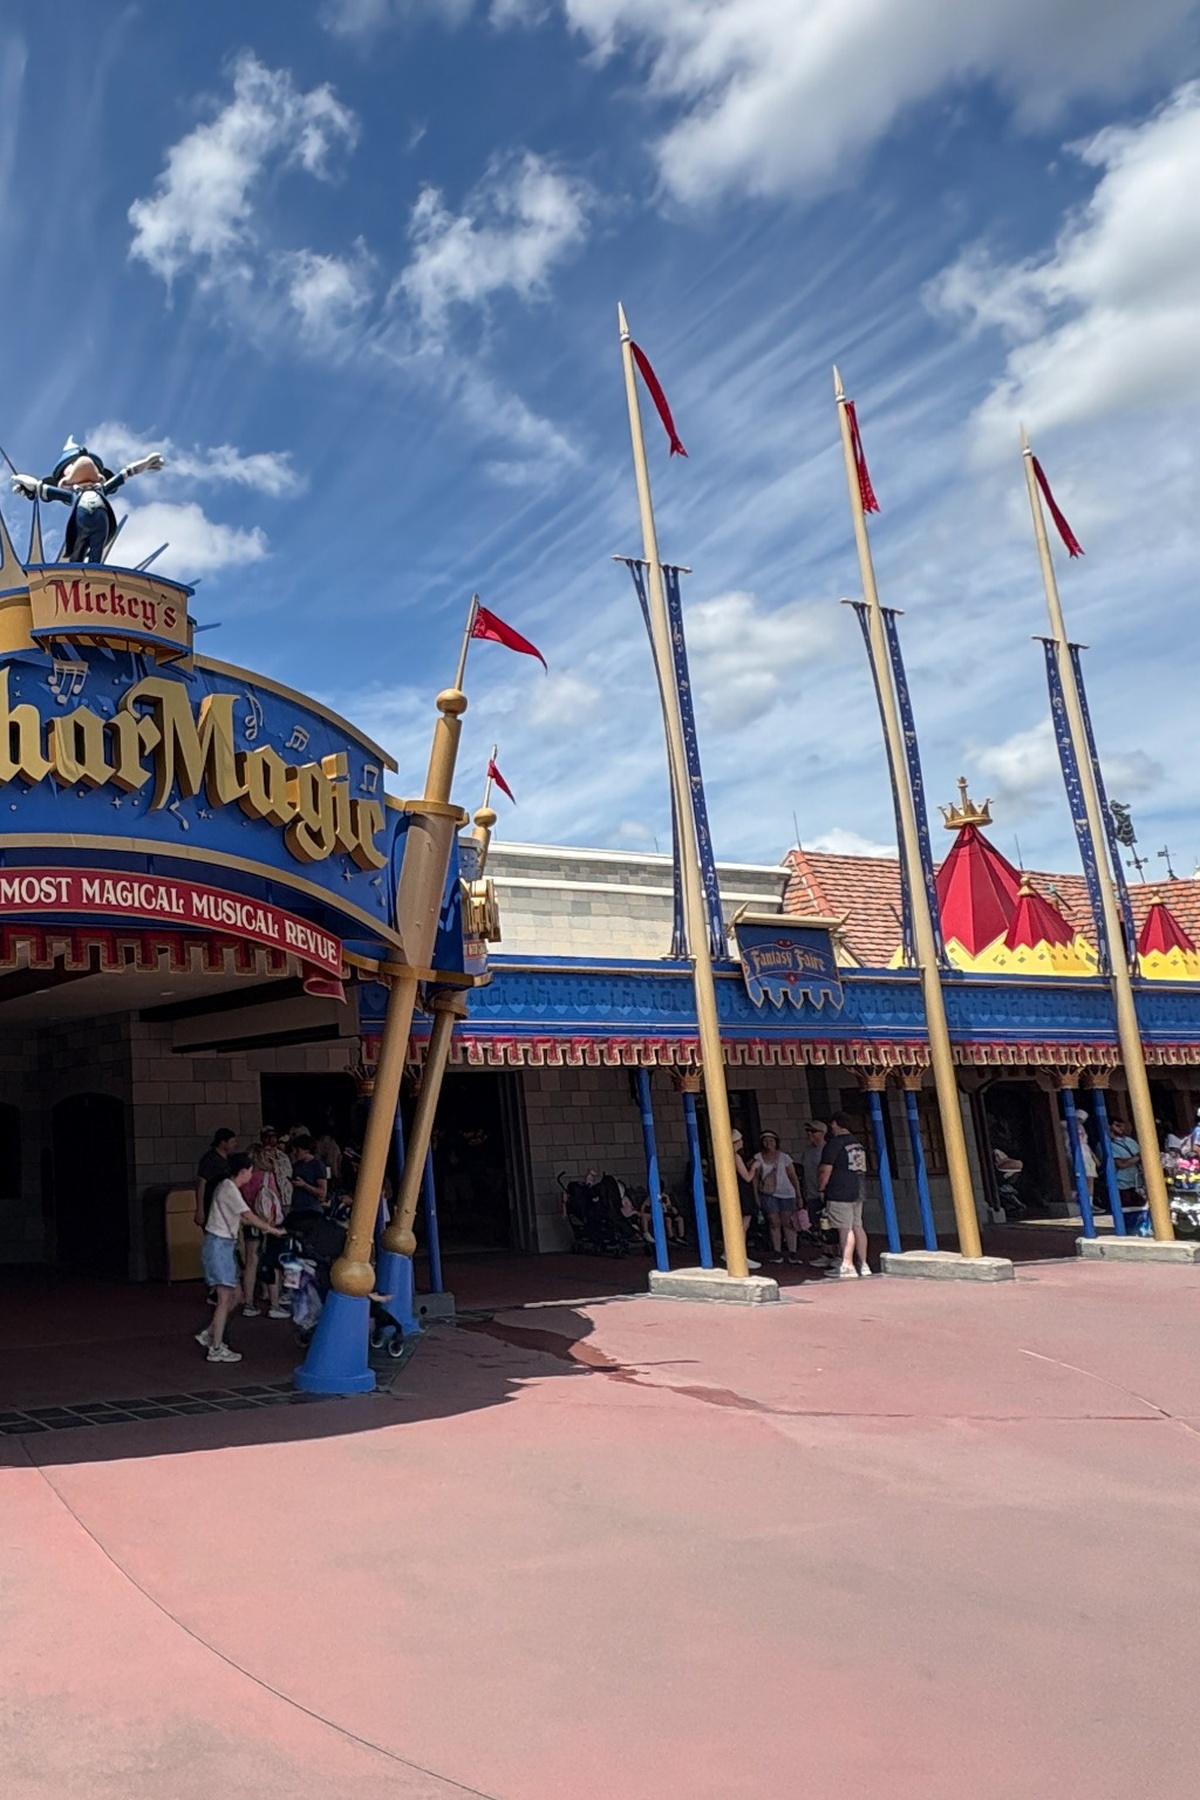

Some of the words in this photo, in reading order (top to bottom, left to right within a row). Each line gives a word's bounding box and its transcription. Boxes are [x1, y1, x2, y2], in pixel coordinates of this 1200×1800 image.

[44, 578, 177, 631] Mickey's
[0, 877, 72, 905] MOST
[81, 877, 185, 915] MAGICAL
[192, 891, 279, 938] MUSICAL
[284, 919, 338, 966] REVUE
[752, 950, 792, 973] Fantasy
[794, 949, 826, 972] Faire
